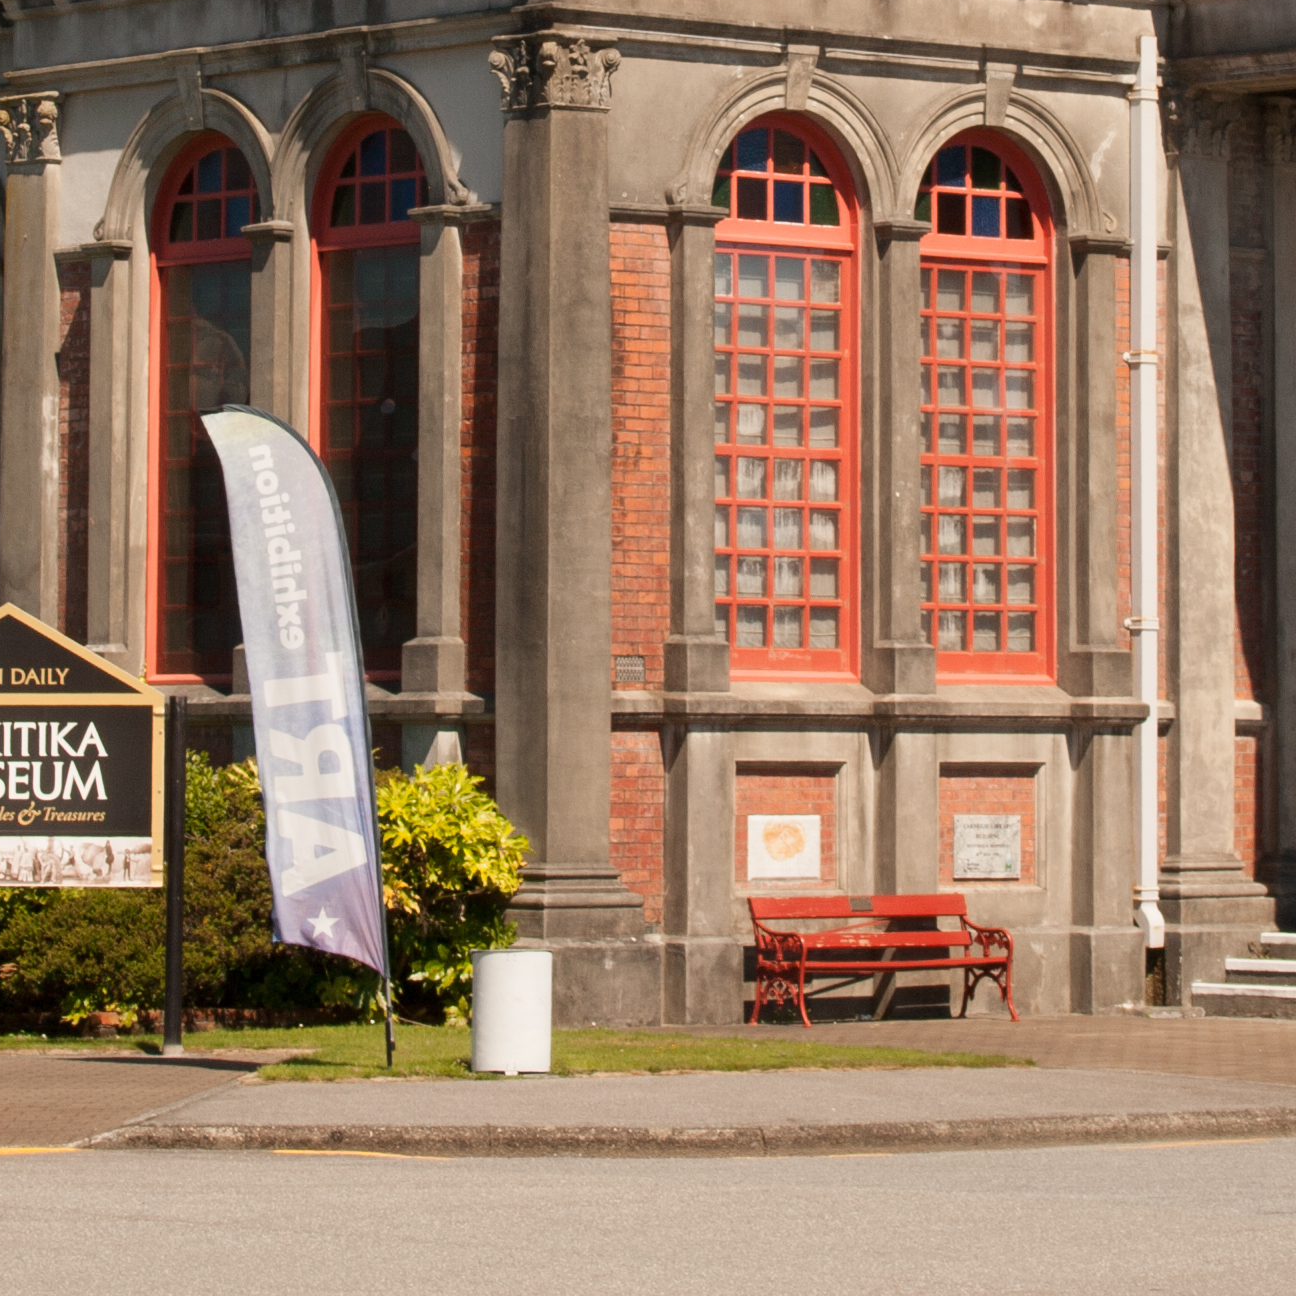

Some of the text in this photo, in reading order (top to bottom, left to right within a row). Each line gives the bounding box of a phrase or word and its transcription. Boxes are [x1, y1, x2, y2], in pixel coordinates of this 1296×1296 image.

[10, 667, 70, 687] DAILY
[17, 800, 42, 826] &
[43, 805, 106, 822] Treasures
